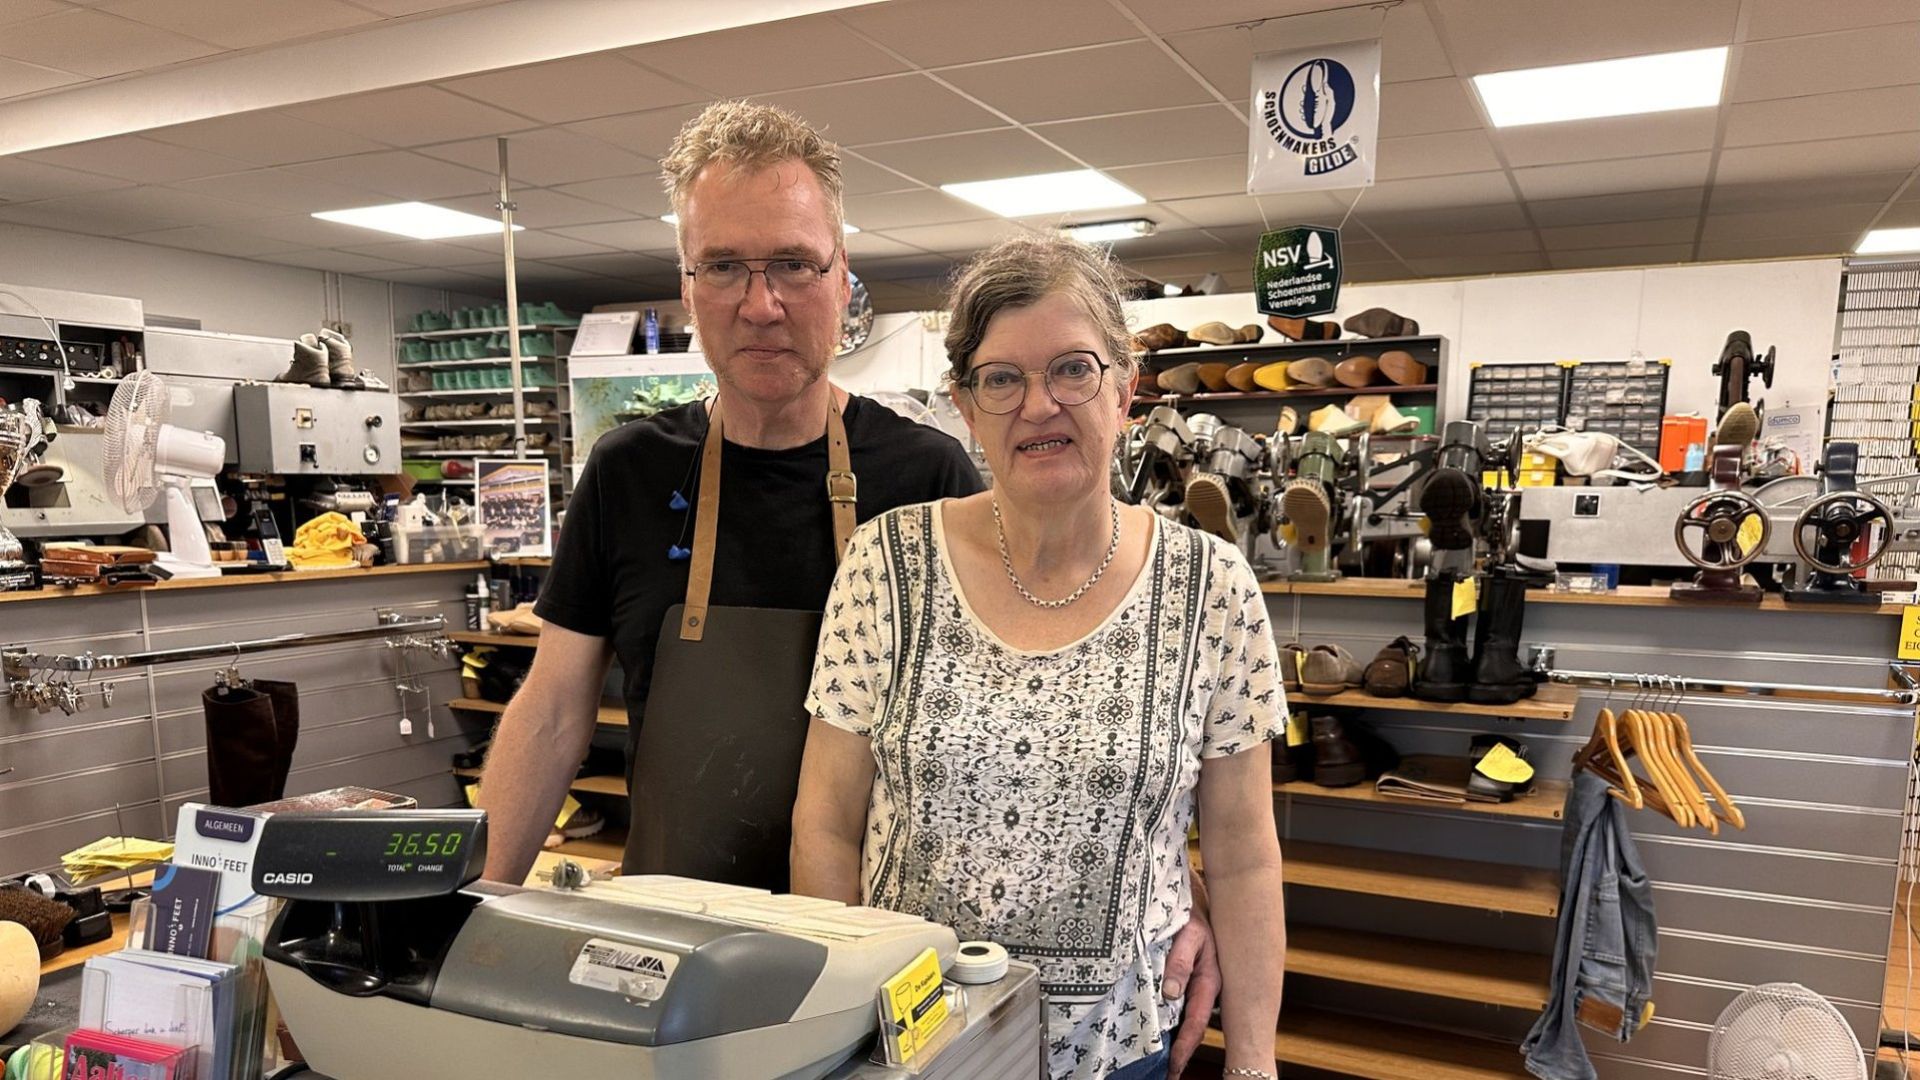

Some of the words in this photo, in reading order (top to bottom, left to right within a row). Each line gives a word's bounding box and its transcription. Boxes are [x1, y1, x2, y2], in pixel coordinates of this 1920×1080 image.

[1264, 91, 1337, 155] SCHOENMAKERS
[1308, 146, 1352, 173] GILDE
[1263, 244, 1301, 269] NSV
[1267, 273, 1322, 289] Nederlandse
[1268, 282, 1331, 300] Schoenmakers
[1269, 294, 1316, 309] Vereniging
[204, 819, 244, 833] ALGEMEEN
[384, 833, 462, 855] 36.50
[191, 853, 217, 868] INNO
[223, 858, 248, 873] FEET
[387, 864, 406, 872] TOTAL
[418, 864, 444, 872] CHANGE
[263, 873, 313, 884] CASIO
[172, 897, 183, 922] FEET
